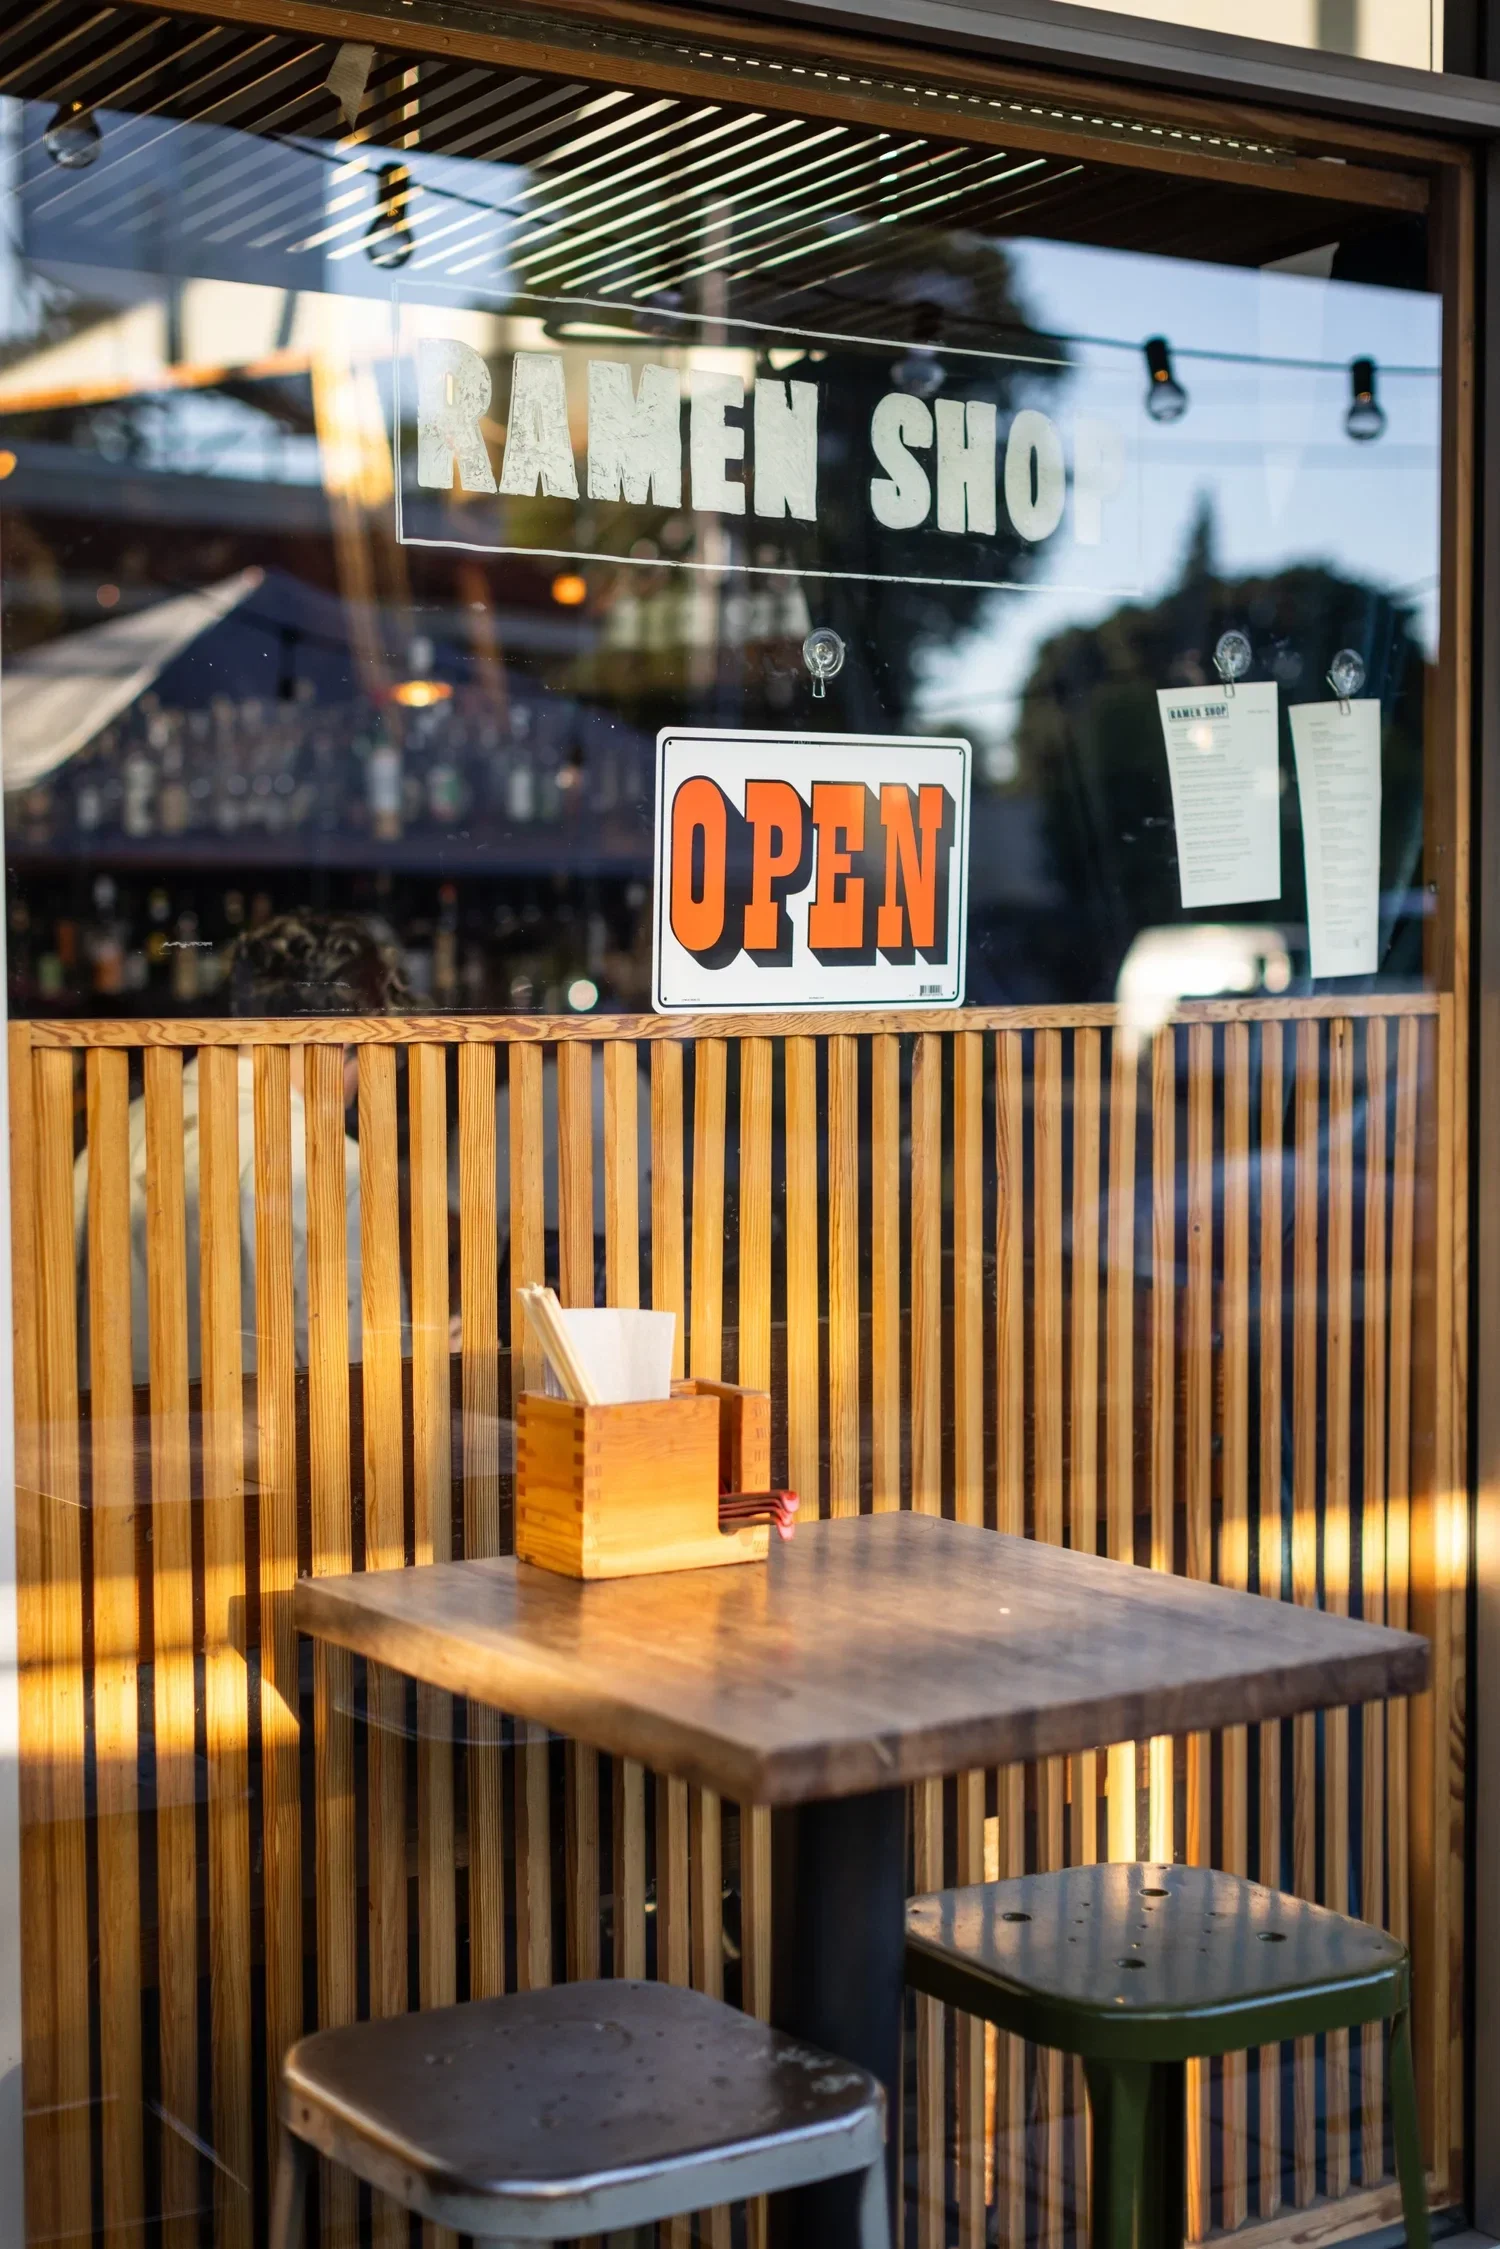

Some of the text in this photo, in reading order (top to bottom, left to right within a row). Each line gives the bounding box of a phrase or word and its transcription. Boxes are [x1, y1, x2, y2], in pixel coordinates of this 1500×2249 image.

[417, 338, 818, 521] RAMEN
[1205, 705, 1226, 716] SHOP
[669, 775, 956, 970] OPEN
